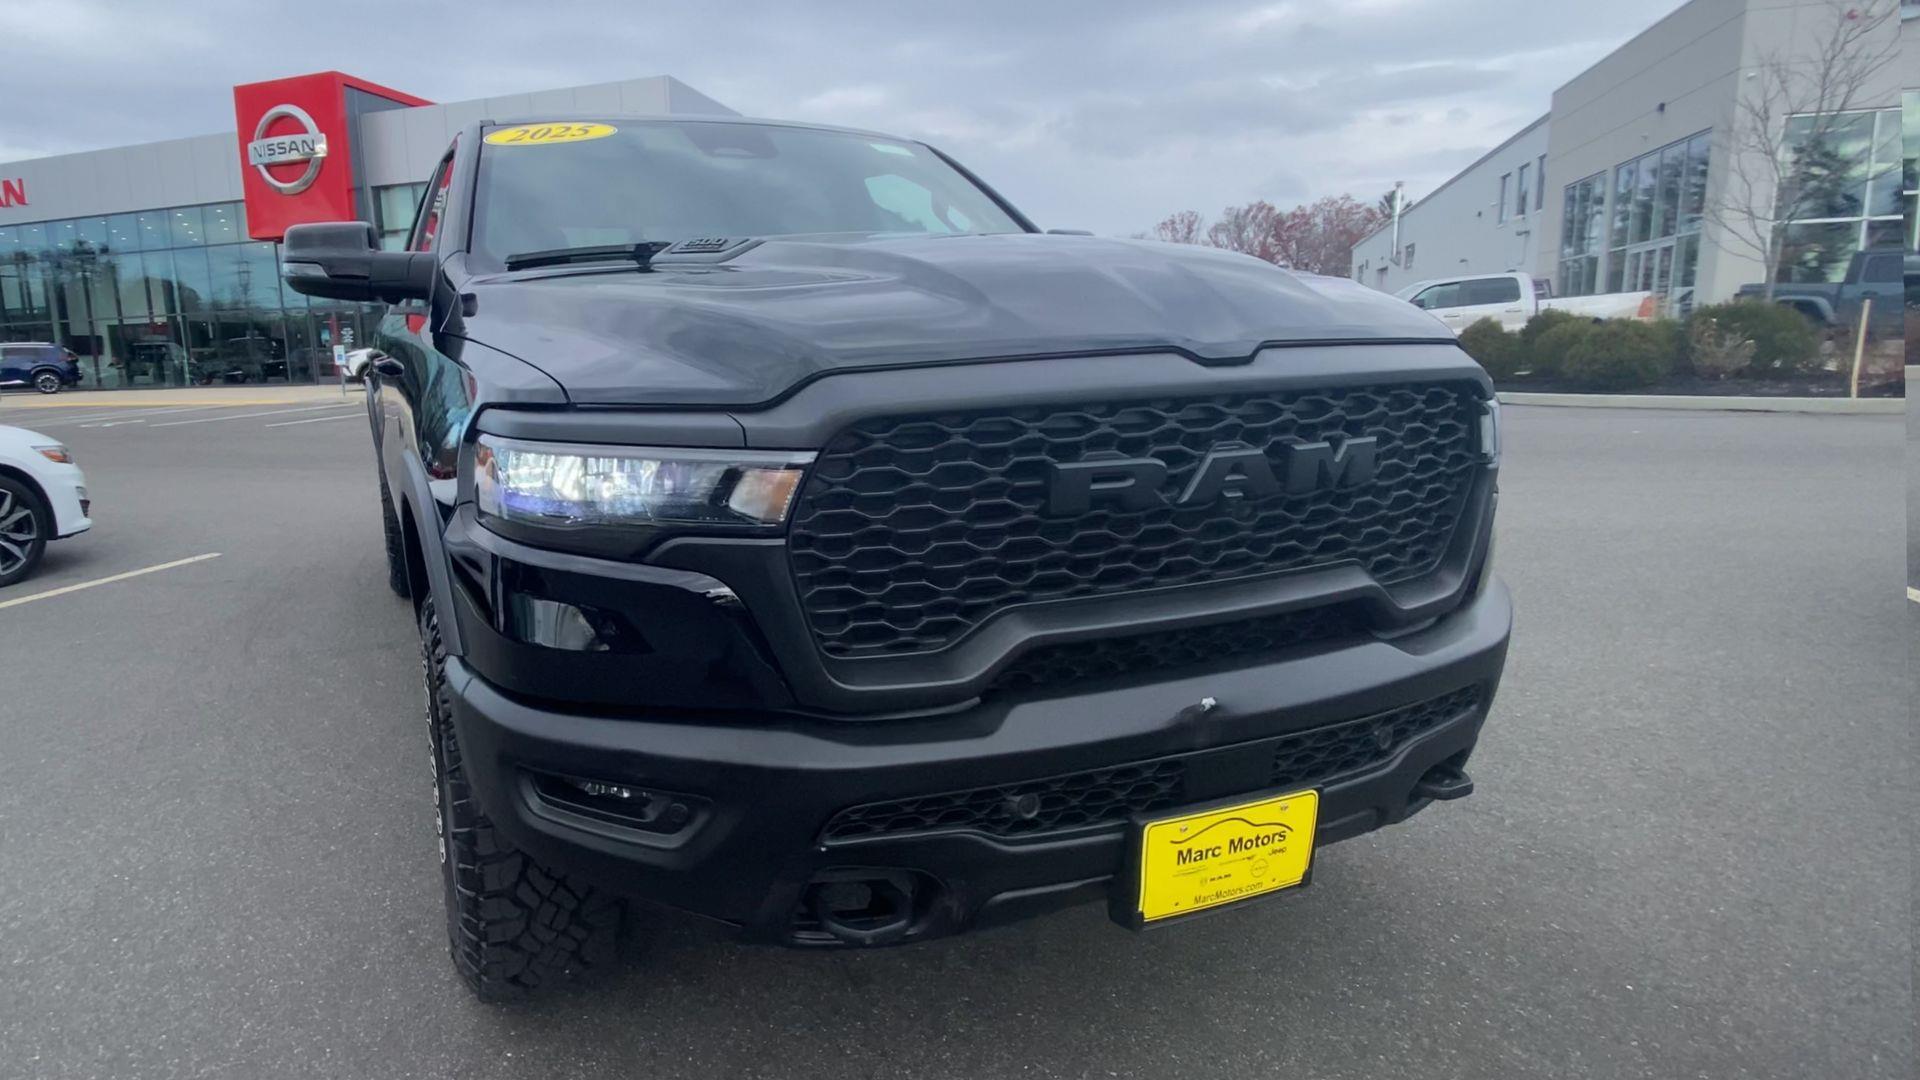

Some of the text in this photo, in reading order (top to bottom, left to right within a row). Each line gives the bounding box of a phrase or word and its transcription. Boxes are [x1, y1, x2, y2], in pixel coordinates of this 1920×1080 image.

[506, 125, 594, 142] 2025
[253, 139, 315, 157] NISSAN
[0, 178, 27, 207] N
[1047, 436, 1378, 516] RAM
[1176, 845, 1221, 866] Marc
[1228, 829, 1287, 855] Motors
[1268, 847, 1287, 857] Jeep
[1193, 882, 1263, 904] MarcMotors.com
